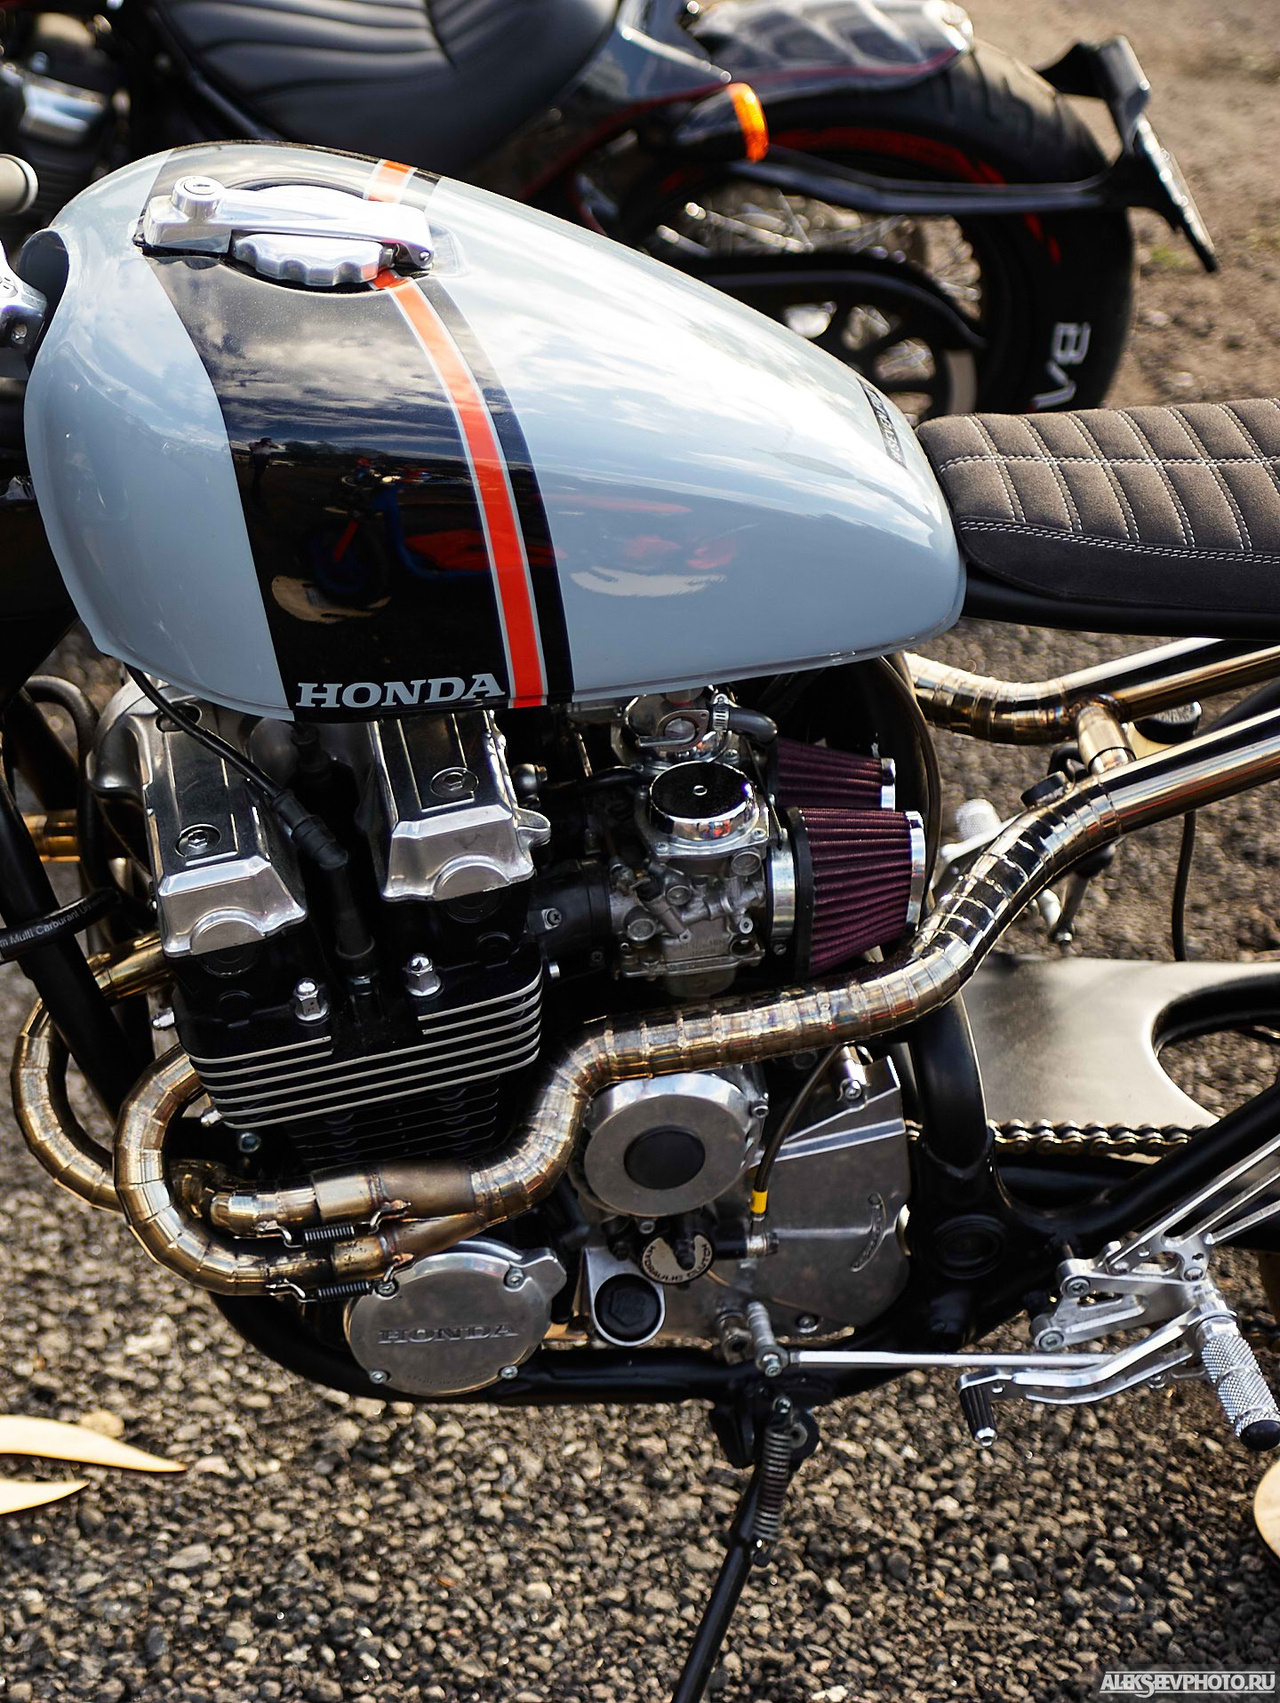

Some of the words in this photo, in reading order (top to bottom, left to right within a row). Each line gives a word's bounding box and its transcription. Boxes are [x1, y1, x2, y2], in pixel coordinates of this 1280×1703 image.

[296, 673, 505, 708] HONDA
[35, 910, 79, 935] Carburant
[645, 1244, 683, 1281] HYDRAULIC
[686, 1243, 712, 1278] CLUTCH
[378, 1324, 519, 1344] HONDA
